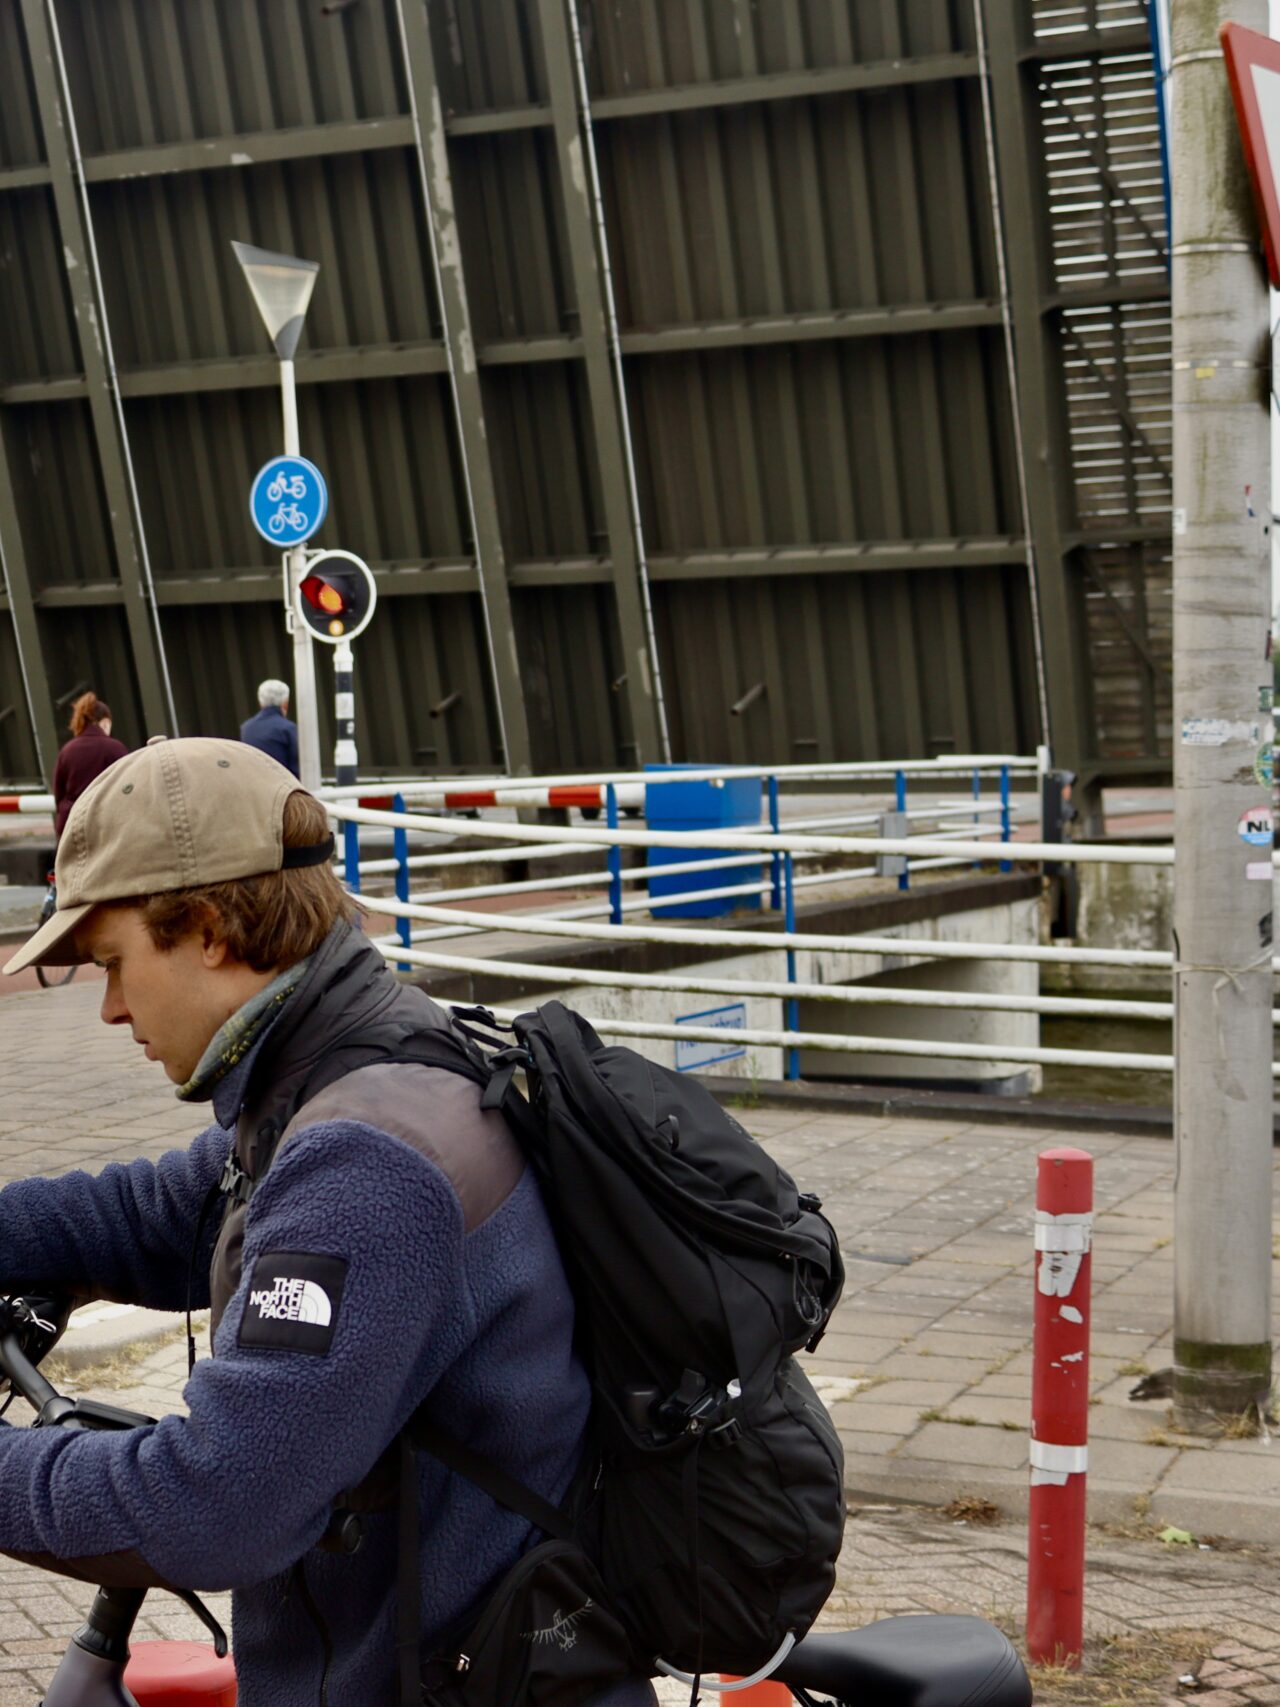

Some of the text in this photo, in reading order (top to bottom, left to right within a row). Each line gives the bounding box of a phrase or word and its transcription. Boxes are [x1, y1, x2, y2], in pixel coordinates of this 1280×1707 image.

[273, 1277, 305, 1292] THE
[249, 1290, 303, 1308] NORTH
[259, 1304, 300, 1321] FACE
